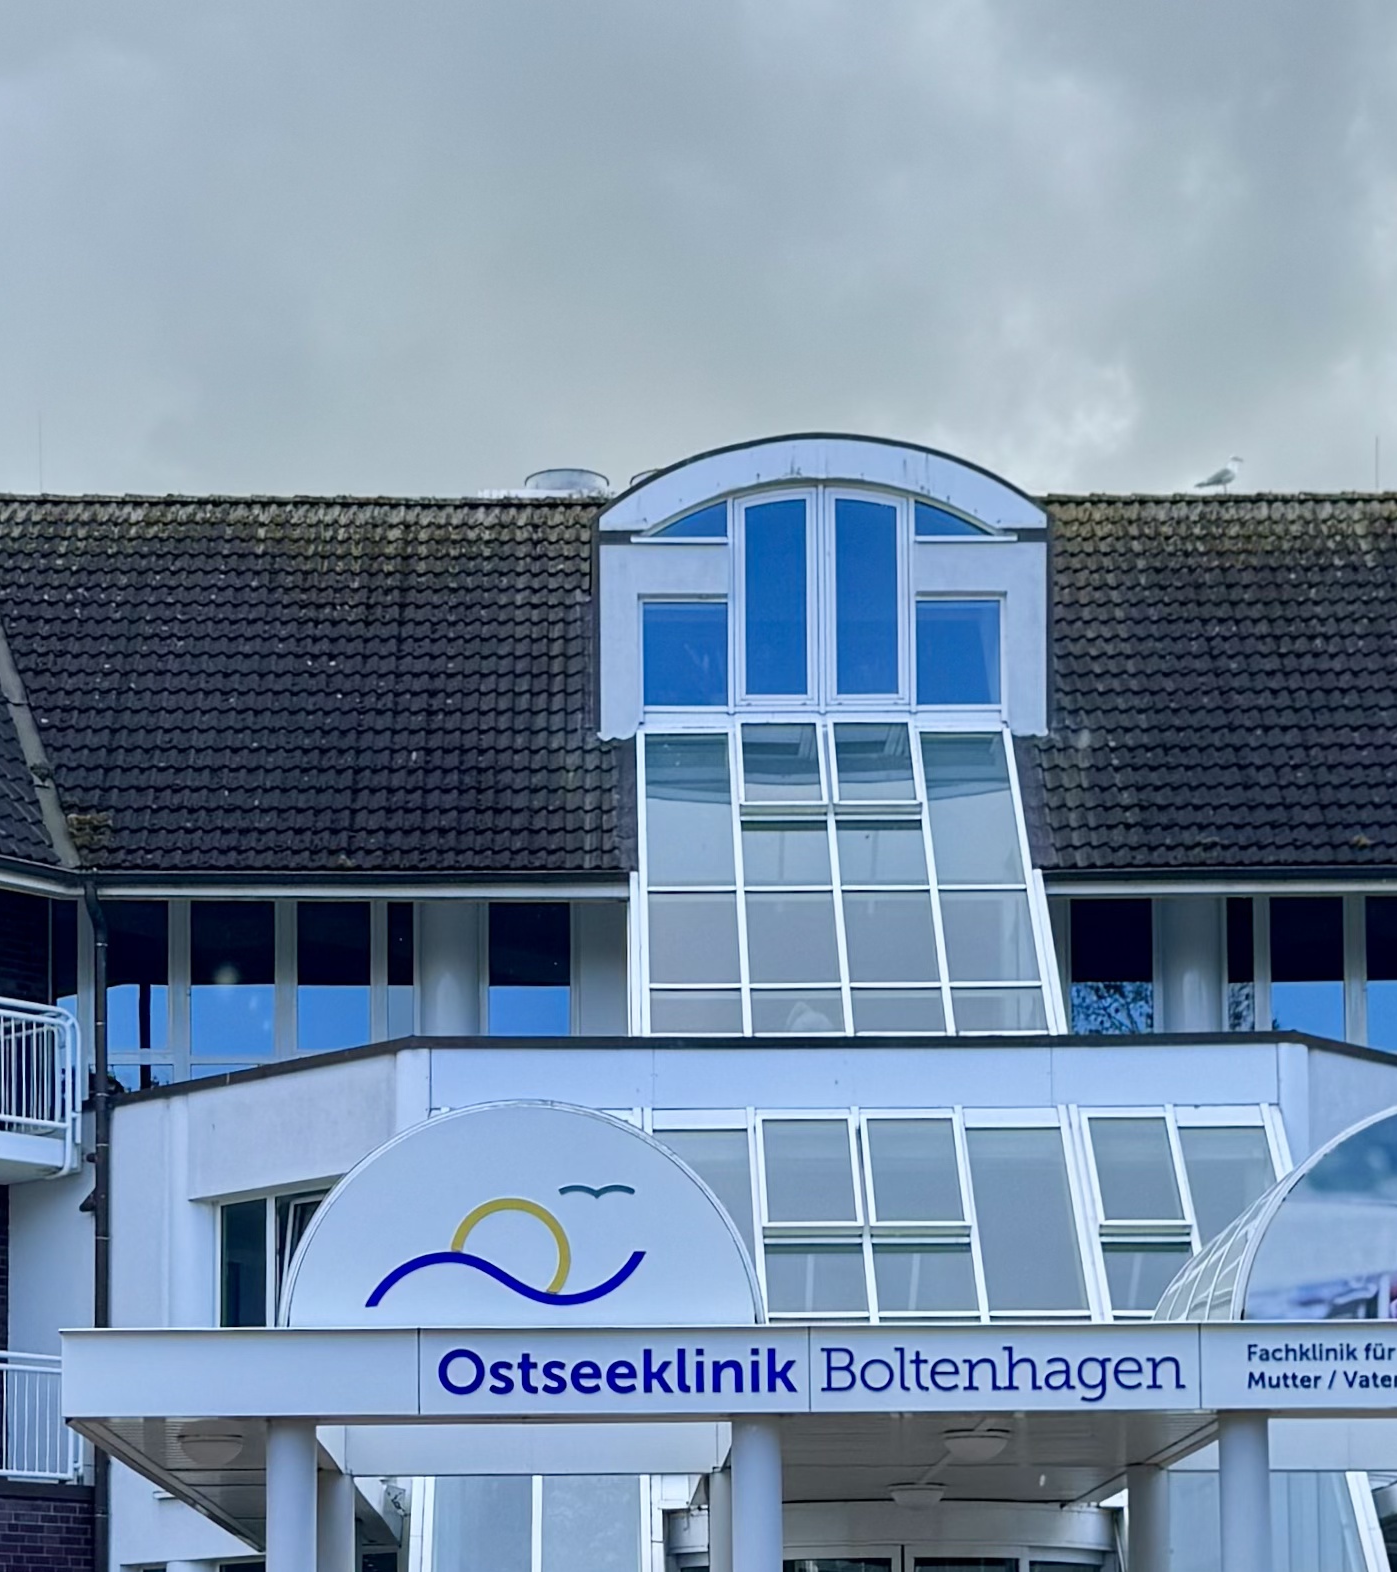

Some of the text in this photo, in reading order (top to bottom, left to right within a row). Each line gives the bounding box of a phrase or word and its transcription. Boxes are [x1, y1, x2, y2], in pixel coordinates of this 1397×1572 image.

[1247, 1343, 1396, 1362] Fachklinik für
[438, 1346, 1186, 1401] Ostseeklinik Boltenhagen
[1247, 1371, 1322, 1389] Mutter
